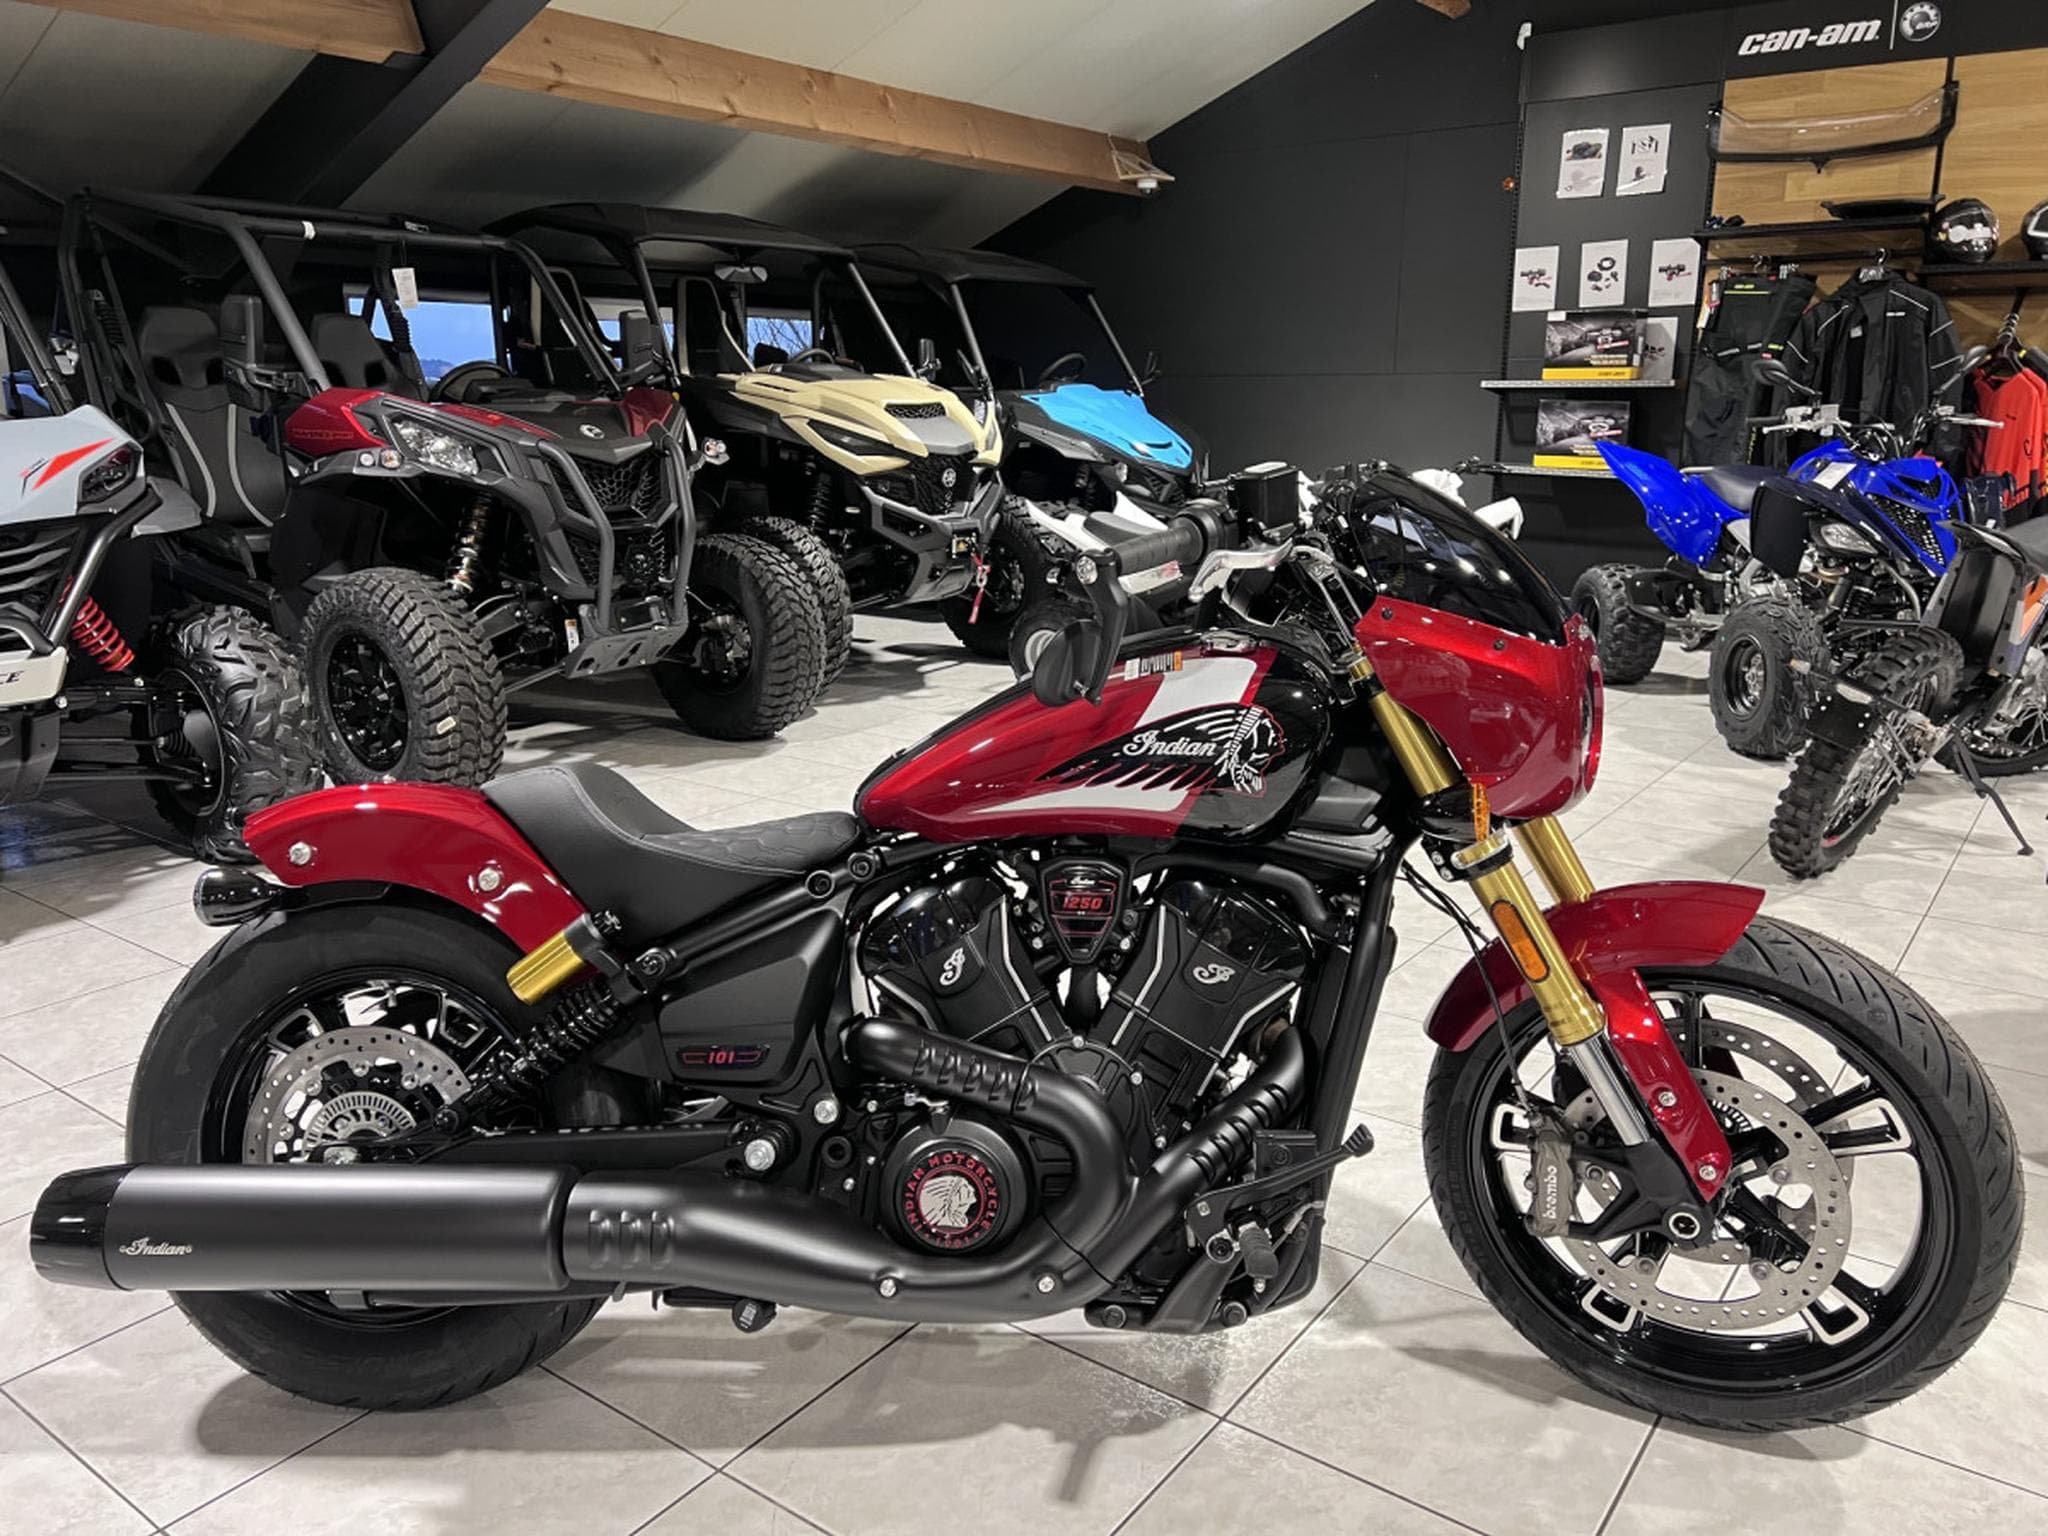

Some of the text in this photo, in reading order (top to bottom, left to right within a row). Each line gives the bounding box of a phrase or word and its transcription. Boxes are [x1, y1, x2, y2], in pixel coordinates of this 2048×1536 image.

[1738, 19, 1881, 56] can-am
[1122, 730, 1218, 756] Indian
[1062, 896, 1103, 910] 1250
[708, 1051, 735, 1064] 101
[905, 1153, 998, 1232] INDIAN MOTORCYCLE
[1542, 1165, 1558, 1219] brembo
[122, 1237, 187, 1255] Indian
